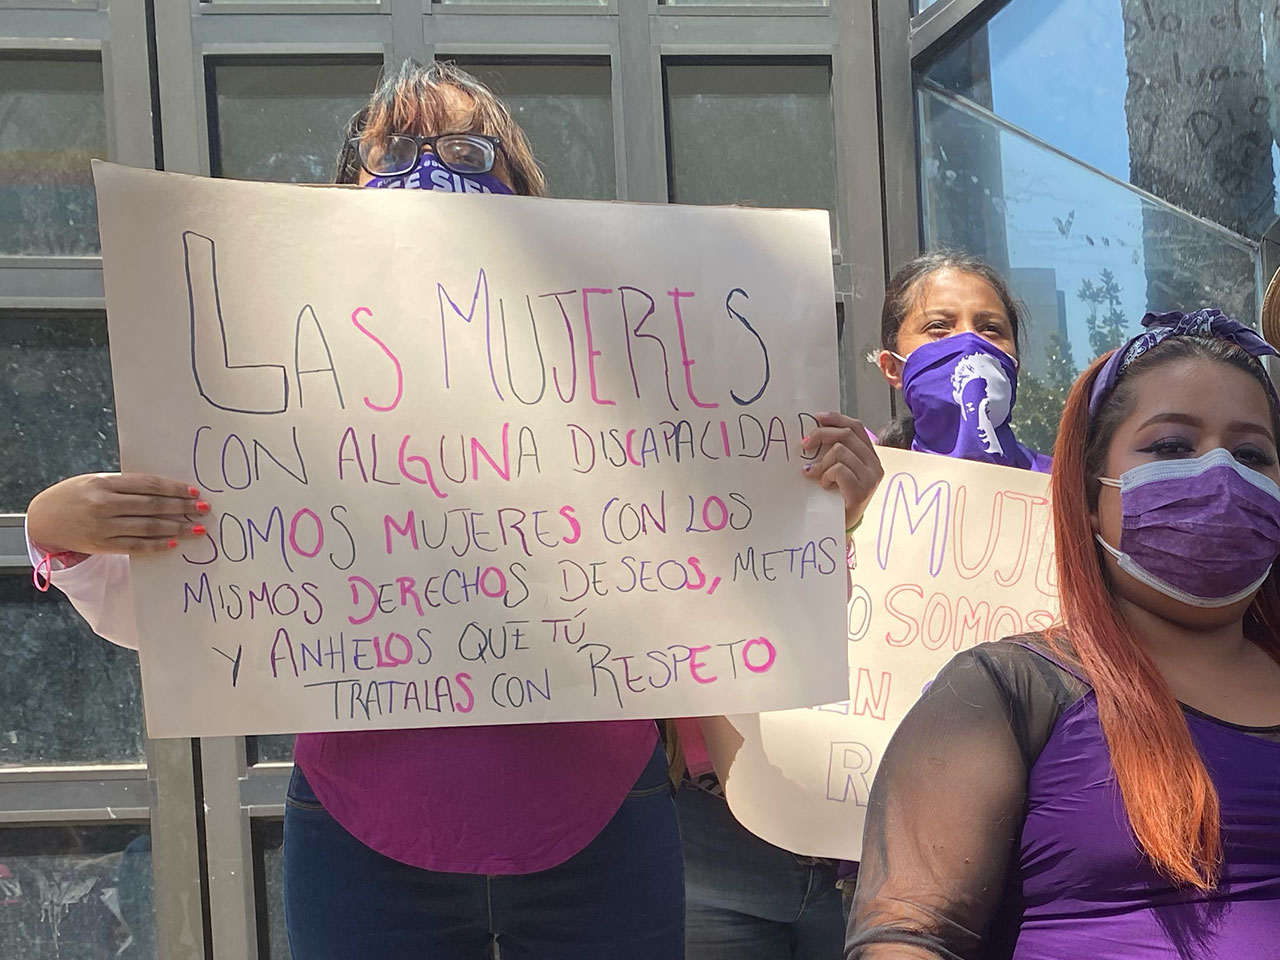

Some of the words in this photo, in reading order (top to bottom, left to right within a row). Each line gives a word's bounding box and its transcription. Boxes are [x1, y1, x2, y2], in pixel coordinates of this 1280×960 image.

[183, 231, 404, 414] LAS
[437, 268, 770, 411] MUJERES
[193, 426, 308, 493] CON
[339, 422, 541, 499] ALGUNA
[570, 412, 823, 474] DISCAPACIDAD
[182, 505, 356, 571] SOMOS
[383, 504, 582, 556] MUJERES
[603, 497, 667, 545] CON
[687, 495, 752, 532] LOS
[183, 582, 323, 624] MISMOS
[348, 562, 530, 626] DERECHOS
[732, 536, 838, 582] METAS
[213, 645, 244, 687] Y
[270, 626, 433, 679] ANHELOS
[458, 618, 530, 664] QUE
[542, 609, 587, 646] TÚ
[303, 671, 475, 722] TRATALAS
[492, 672, 552, 708] CON
[578, 636, 777, 709] RESPETO
